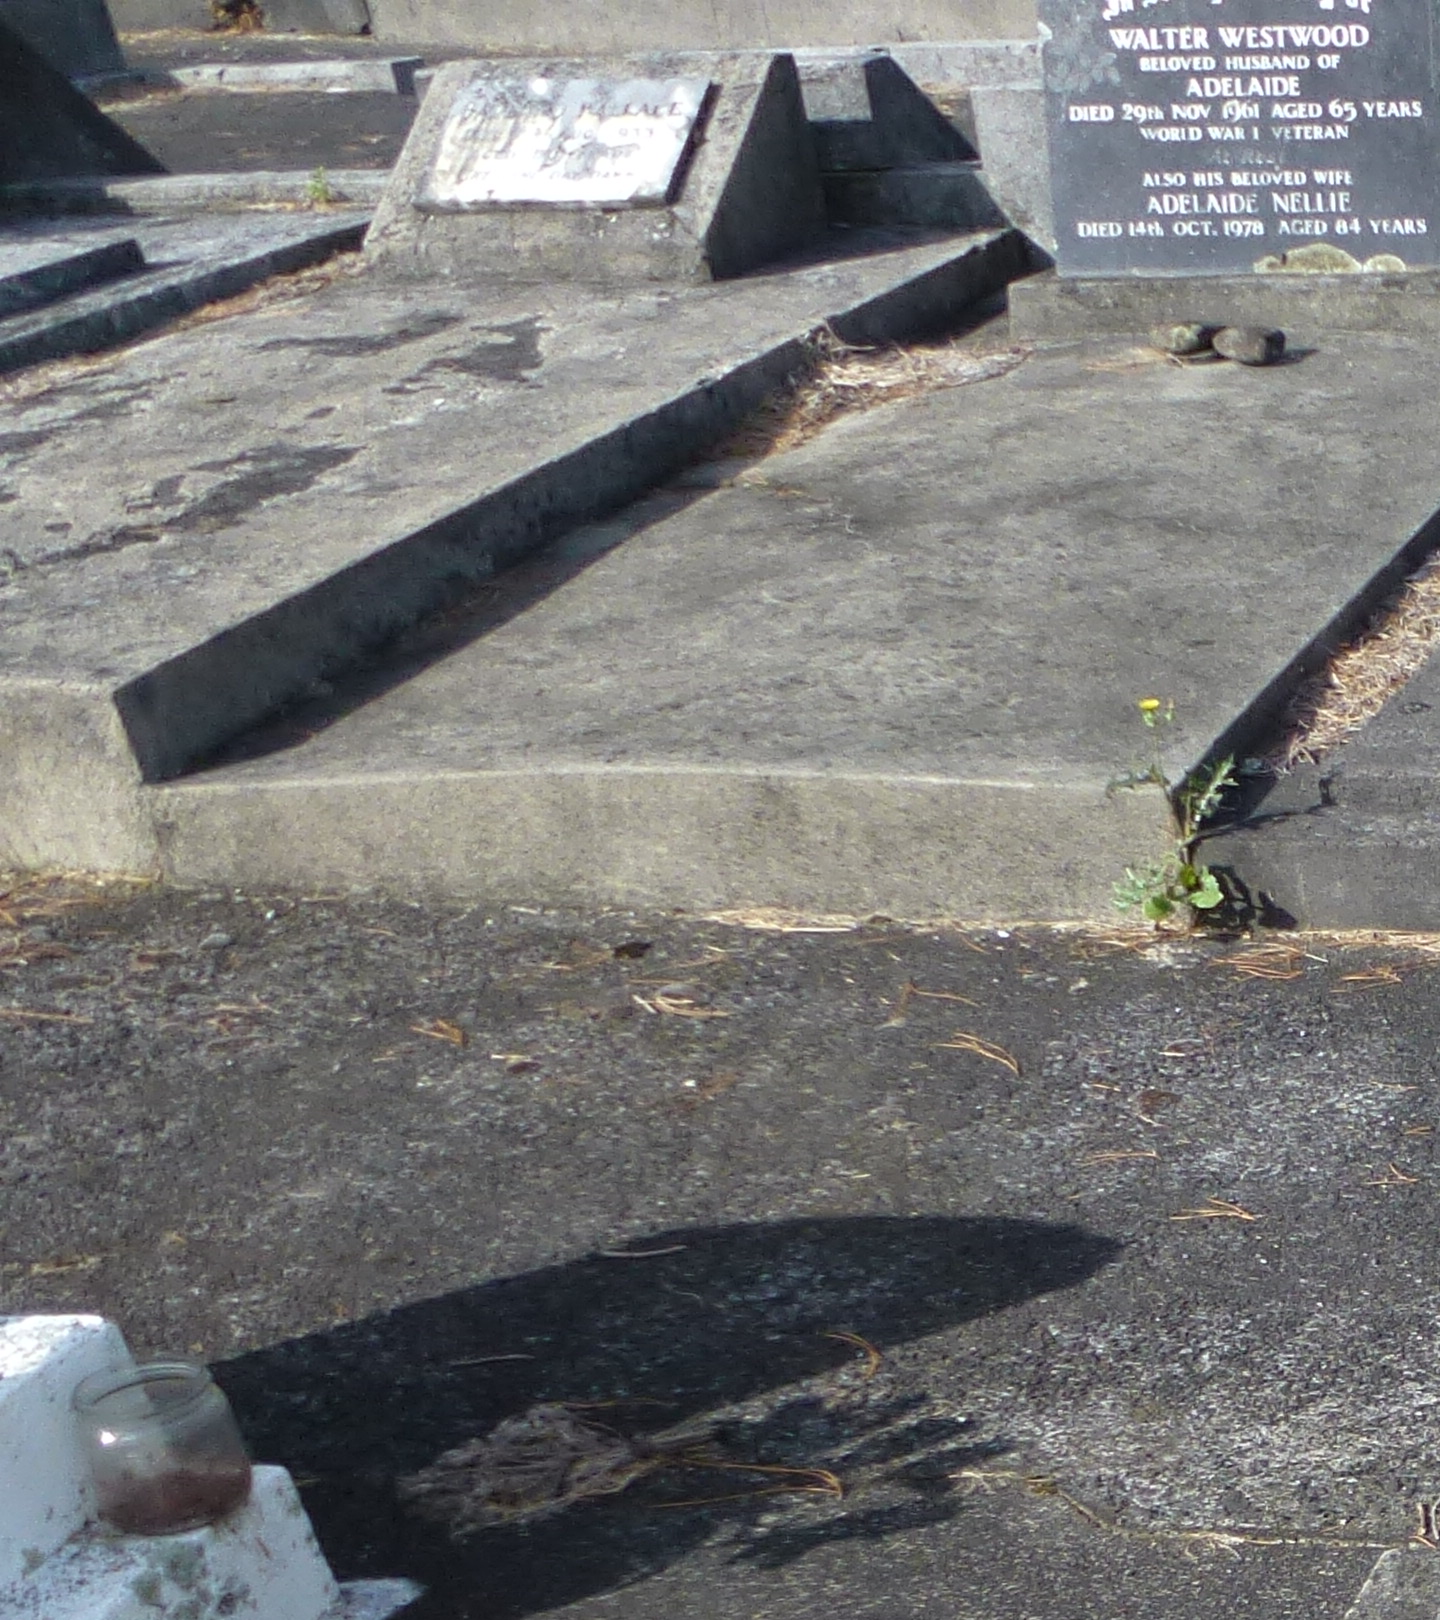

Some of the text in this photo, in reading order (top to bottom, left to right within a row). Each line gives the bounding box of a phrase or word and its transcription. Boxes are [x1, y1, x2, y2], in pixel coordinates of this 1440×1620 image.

[1108, 24, 1370, 51] WALTER WESTWOOD
[1139, 54, 1341, 72] BELOVED HUSBAND OF
[1186, 75, 1301, 98] ADELAIDE
[1069, 100, 1423, 123] DIED 29th NOV 1961 AGED 65 YEARS
[1140, 127, 1203, 142] WORLD
[1208, 126, 1246, 141] WAR
[1272, 126, 1349, 141] VETERAN
[1142, 171, 1354, 188] ALSO HIS BELOVED WIFE
[1147, 192, 1352, 215] ADELAIDE NELLIE
[1077, 222, 1123, 238] DIED
[1128, 221, 1164, 238] 14th
[1224, 221, 1265, 237] 1978
[1278, 220, 1328, 236] AGED
[1335, 220, 1361, 236] 84
[1369, 219, 1428, 235] YEARS
